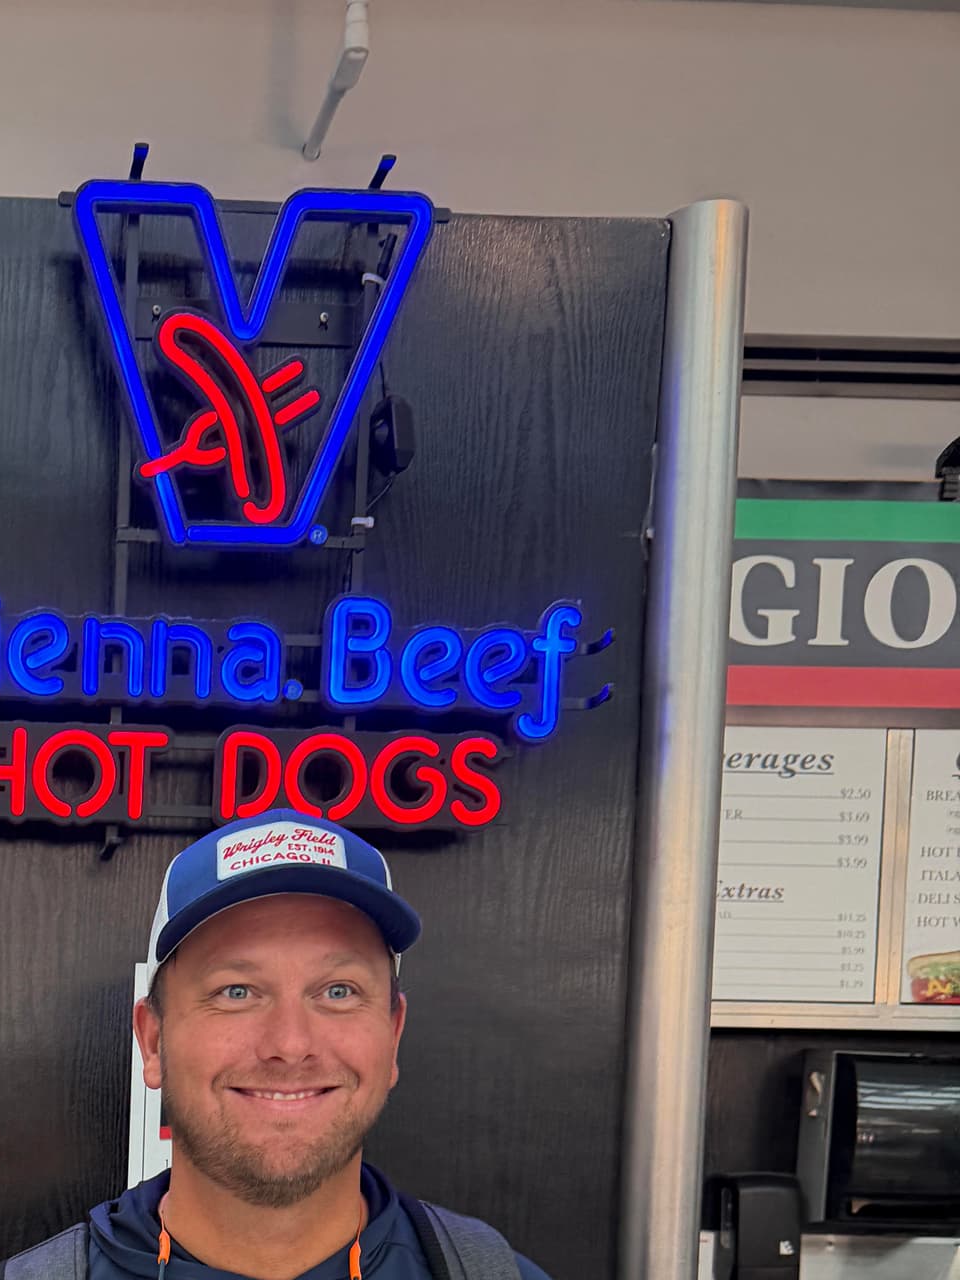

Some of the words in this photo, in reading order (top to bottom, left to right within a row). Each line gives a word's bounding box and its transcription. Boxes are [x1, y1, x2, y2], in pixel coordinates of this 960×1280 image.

[729, 554, 958, 649] GIO
[329, 596, 583, 738] Beef
[724, 751, 835, 779] erages
[220, 731, 502, 827] DOGS
[724, 808, 744, 821] ER
[223, 830, 288, 860] Wrigley
[291, 828, 337, 846] Field
[287, 843, 312, 852] EST.
[313, 845, 335, 856] 1914
[920, 846, 952, 859] HOT
[230, 852, 316, 870] CHICAGO,
[717, 880, 785, 899] xtras
[916, 915, 947, 928] HOT
